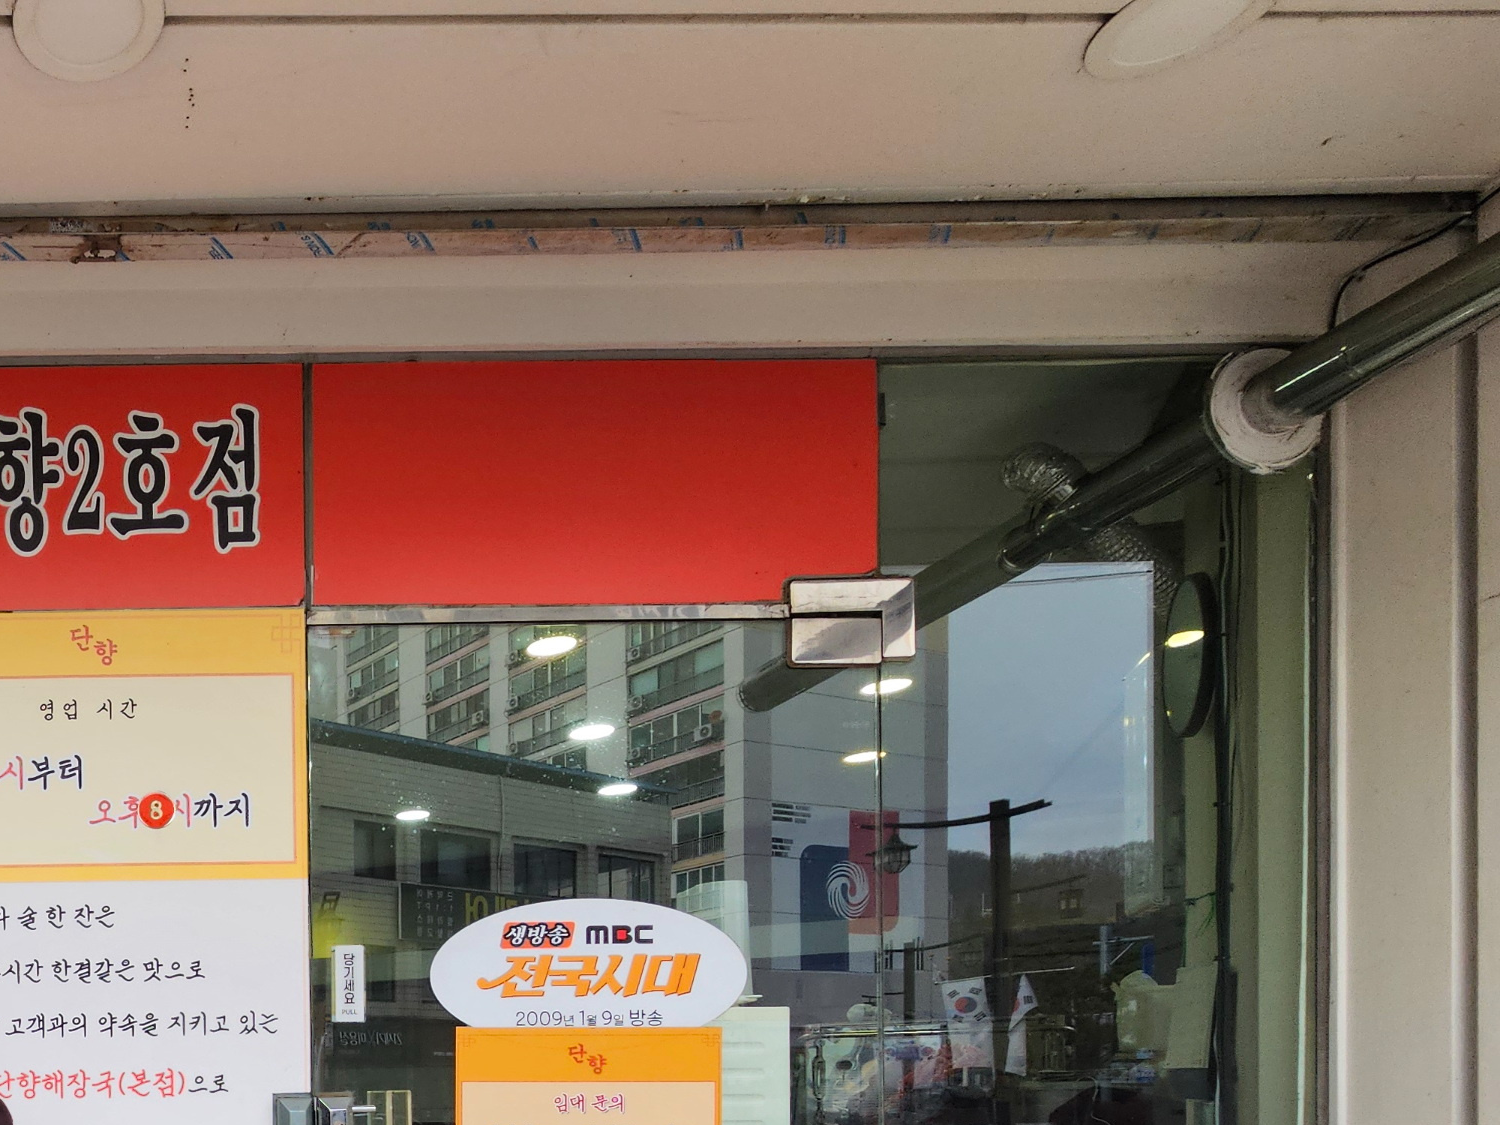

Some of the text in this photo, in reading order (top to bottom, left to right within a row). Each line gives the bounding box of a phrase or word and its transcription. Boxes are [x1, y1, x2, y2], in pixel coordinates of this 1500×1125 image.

[70, 625, 117, 666] 단향
[39, 698, 138, 722] 영업 시간
[89, 794, 139, 829] 오후
[17, 905, 38, 931] 술
[46, 905, 67, 930] 한
[74, 903, 115, 929] 잔은
[504, 923, 571, 947] 생방송
[585, 925, 654, 945] MBC
[51, 958, 136, 984] 한결같은
[143, 957, 206, 982] 맛으로
[343, 953, 355, 1004] 당기세요
[476, 953, 701, 998] 전국시대
[5, 1012, 89, 1039] 고객과의
[99, 1012, 160, 1037] 약속을
[167, 1010, 230, 1036] 지키고
[239, 1010, 279, 1035] 있는
[515, 1008, 663, 1029] 2009년 1월 9일 방송
[567, 1043, 607, 1075] 단향
[554, 1093, 626, 1113] 임대 문의
